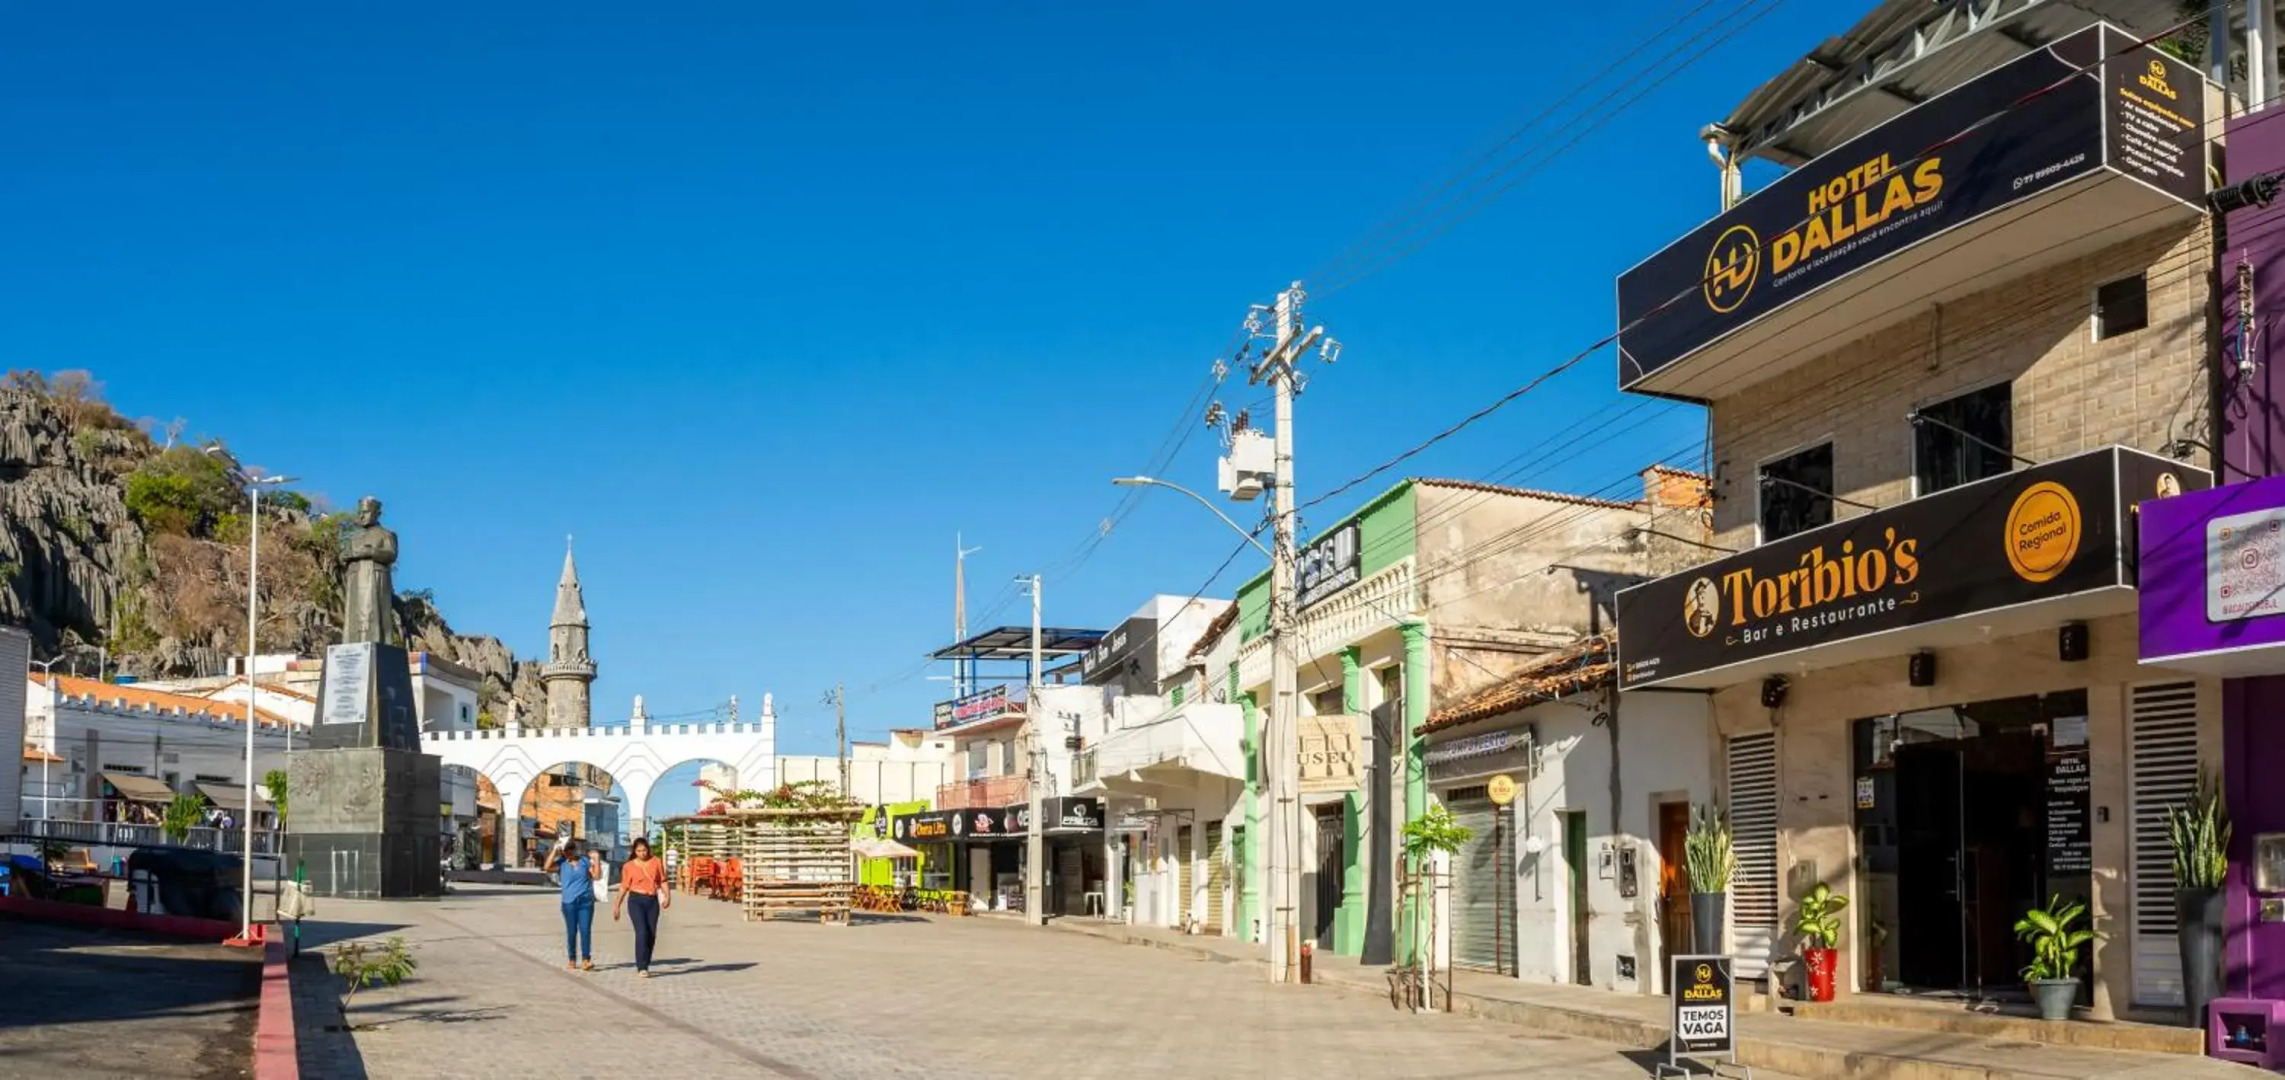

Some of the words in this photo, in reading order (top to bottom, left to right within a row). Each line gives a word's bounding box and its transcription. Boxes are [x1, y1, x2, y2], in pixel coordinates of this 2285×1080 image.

[2139, 75, 2177, 99] DALLAS
[1808, 153, 1899, 214] HOTEL
[1772, 157, 1944, 275] DALLAS
[2020, 512, 2061, 535] Comida
[2019, 521, 2066, 552] Regional
[1743, 627, 1768, 644] Bar
[1776, 624, 1784, 637] e
[1791, 596, 1896, 632] Restaurante
[1297, 752, 1355, 765] USEU
[2056, 764, 2086, 774] DALLAS
[1684, 989, 1723, 999] DALLAS
[1683, 1010, 1724, 1021] TEMOS
[1683, 1022, 1724, 1035] VAGA
